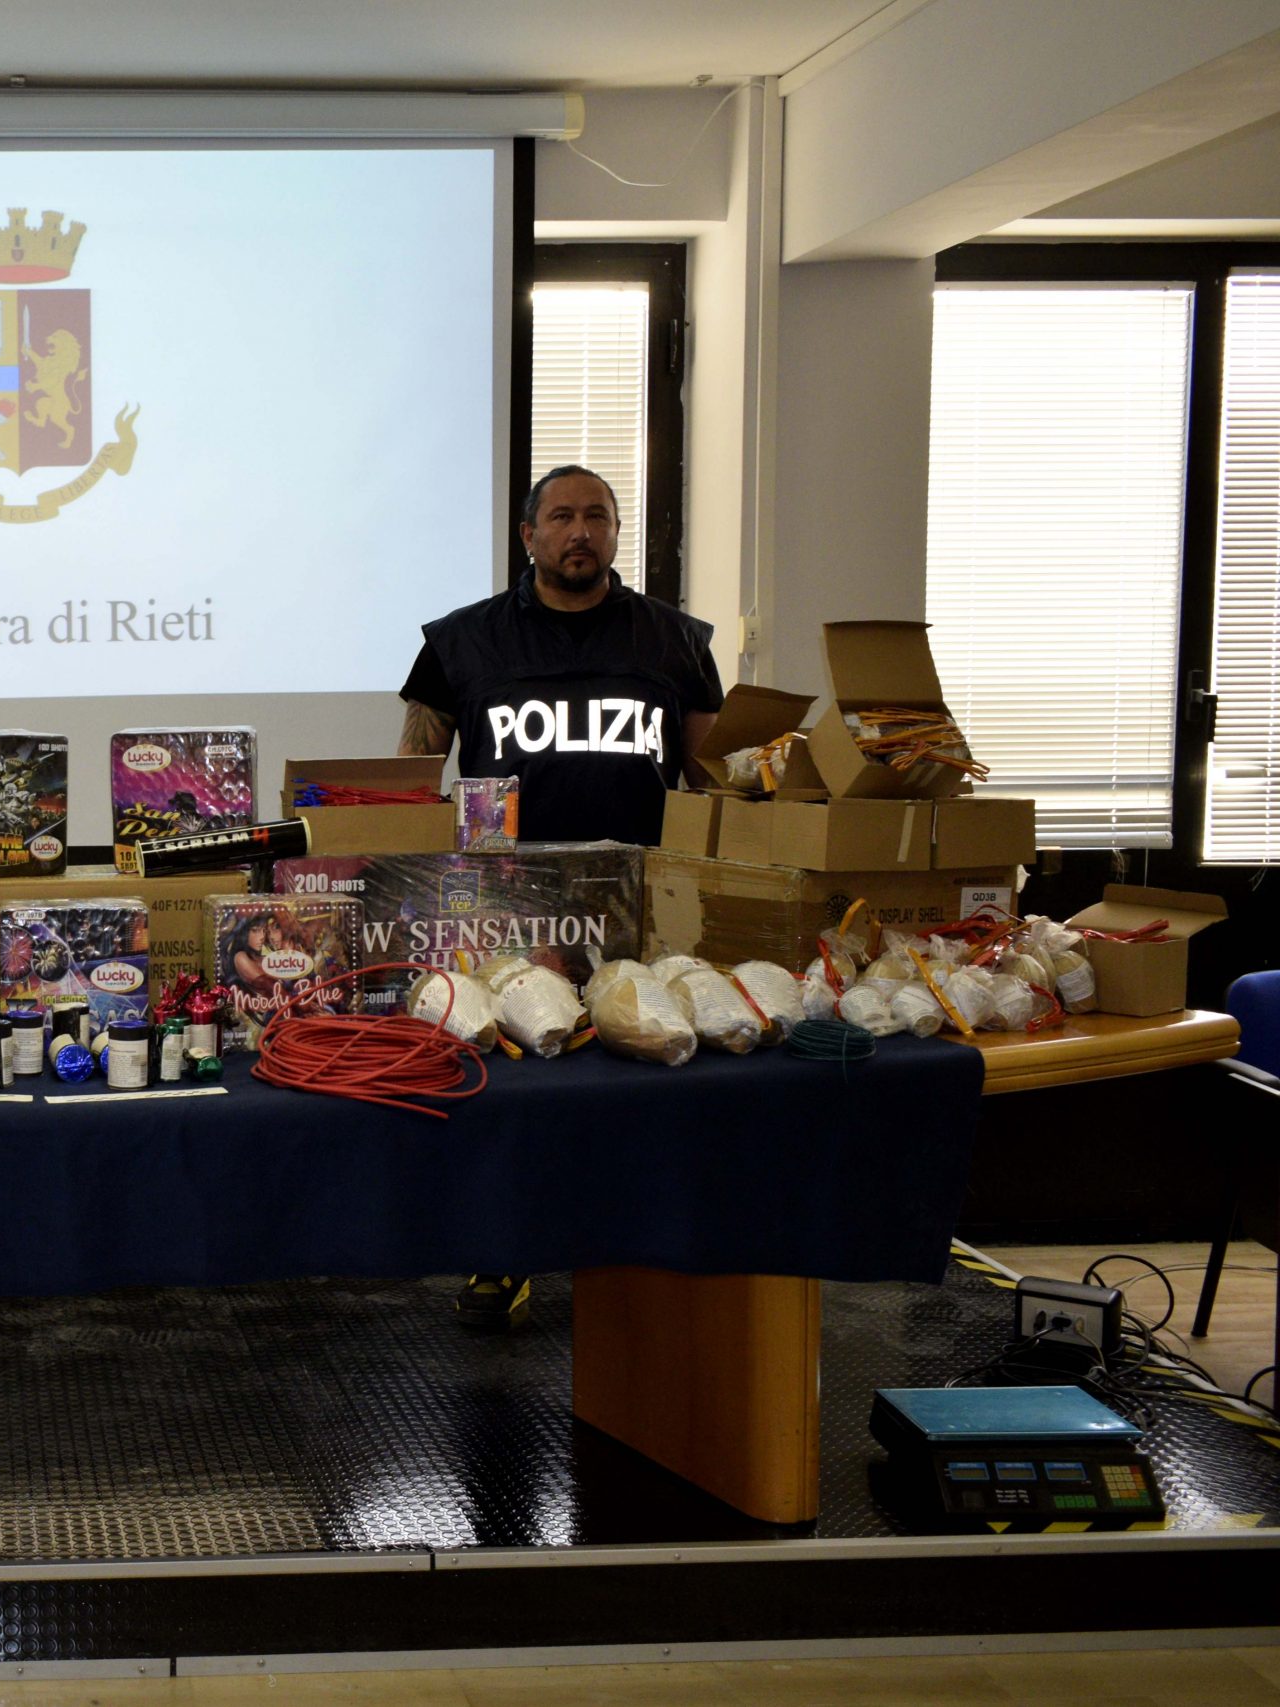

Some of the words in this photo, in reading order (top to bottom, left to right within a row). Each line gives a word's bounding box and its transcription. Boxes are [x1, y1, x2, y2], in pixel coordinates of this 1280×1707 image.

[48, 600, 90, 645] di
[107, 598, 216, 643] Rieti
[487, 698, 664, 764] POLIZIA
[128, 751, 163, 765] Lucky
[123, 801, 181, 821] San
[35, 842, 58, 854] Lucky
[165, 832, 250, 851] SCREAM
[295, 873, 329, 893] 200
[331, 879, 366, 892] SHOTS
[448, 894, 473, 902] PYRO
[449, 901, 471, 910] TOP
[972, 892, 997, 902] QD3B
[879, 907, 914, 924] DISPLAY
[919, 906, 946, 923] SHELL
[409, 914, 608, 952] SENSATION
[267, 956, 305, 971] Lucky
[96, 970, 136, 985] Lucky
[227, 981, 291, 1019] Moody
[294, 974, 344, 1007] Blue
